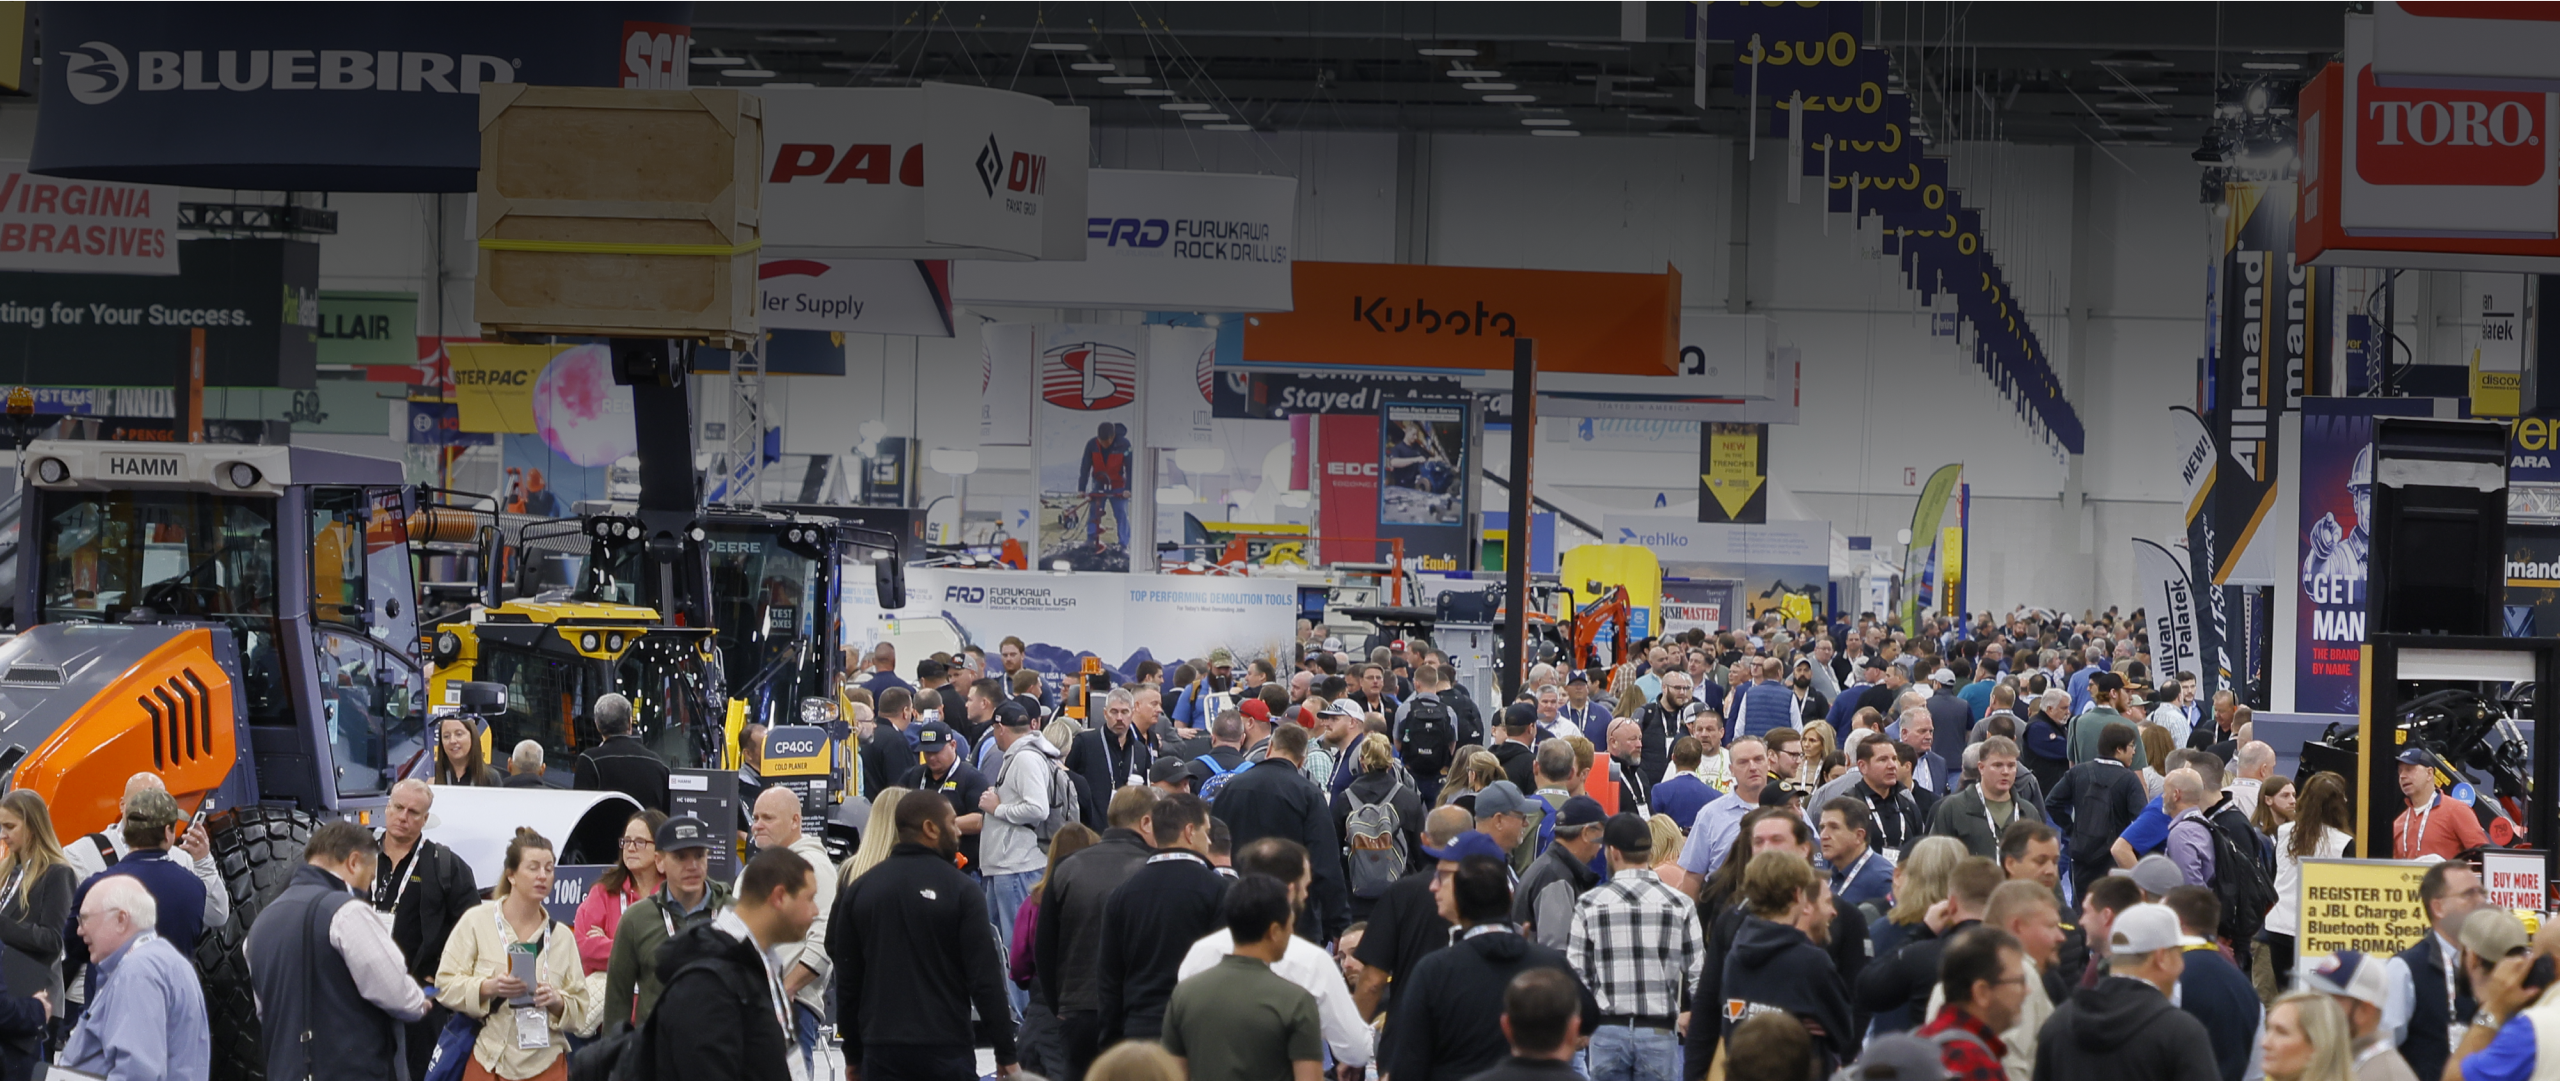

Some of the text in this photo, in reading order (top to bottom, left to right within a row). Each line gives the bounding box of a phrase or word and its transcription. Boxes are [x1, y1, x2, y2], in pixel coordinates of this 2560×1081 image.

[624, 31, 690, 90] SCA
[139, 49, 515, 94] BLUEBIRD
[2369, 101, 2535, 147] TORO
[1175, 220, 1269, 242] FURUKAWA
[1, 223, 165, 259] BRASIVES
[1174, 241, 1227, 261] ROCK
[1231, 243, 1269, 263] DRILL
[795, 293, 864, 319] Supply
[0, 302, 251, 329] ting for Your Success.
[1354, 296, 1516, 338] Kubota
[318, 313, 390, 341] LLAIR
[2230, 250, 2267, 482] Allmand
[1281, 386, 1368, 413] Stayed
[1722, 442, 1745, 450] NEW
[111, 457, 178, 476] HAMM
[1713, 460, 1754, 468] TRENCHES
[2182, 434, 2211, 486] NEW!
[1640, 532, 1688, 547] rehlko
[1385, 553, 1457, 571] SartEquip
[945, 586, 984, 603] FRD
[990, 587, 1051, 597] FURUKAWA
[1130, 590, 1292, 606] TOP PERFORMING DEMOLITION TOOLS
[990, 597, 1076, 607] ROCK DRILL USA
[771, 608, 793, 618] TEST
[2170, 577, 2194, 658] Palatek
[2313, 609, 2366, 641] MAN
[2313, 647, 2360, 662] THE BRAND
[2312, 663, 2323, 675] BY
[775, 740, 813, 754] CP40G
[775, 762, 808, 771] COLD PLANER
[2493, 872, 2539, 890] BUY MORE
[2309, 886, 2379, 902] REGISTER
[2385, 888, 2403, 902] TO
[2491, 891, 2542, 909] SAVE MORE
[2308, 904, 2421, 922] a JBL Charge 4
[2308, 920, 2379, 936] Bluetooth
[2307, 938, 2406, 953] From BOMAG
